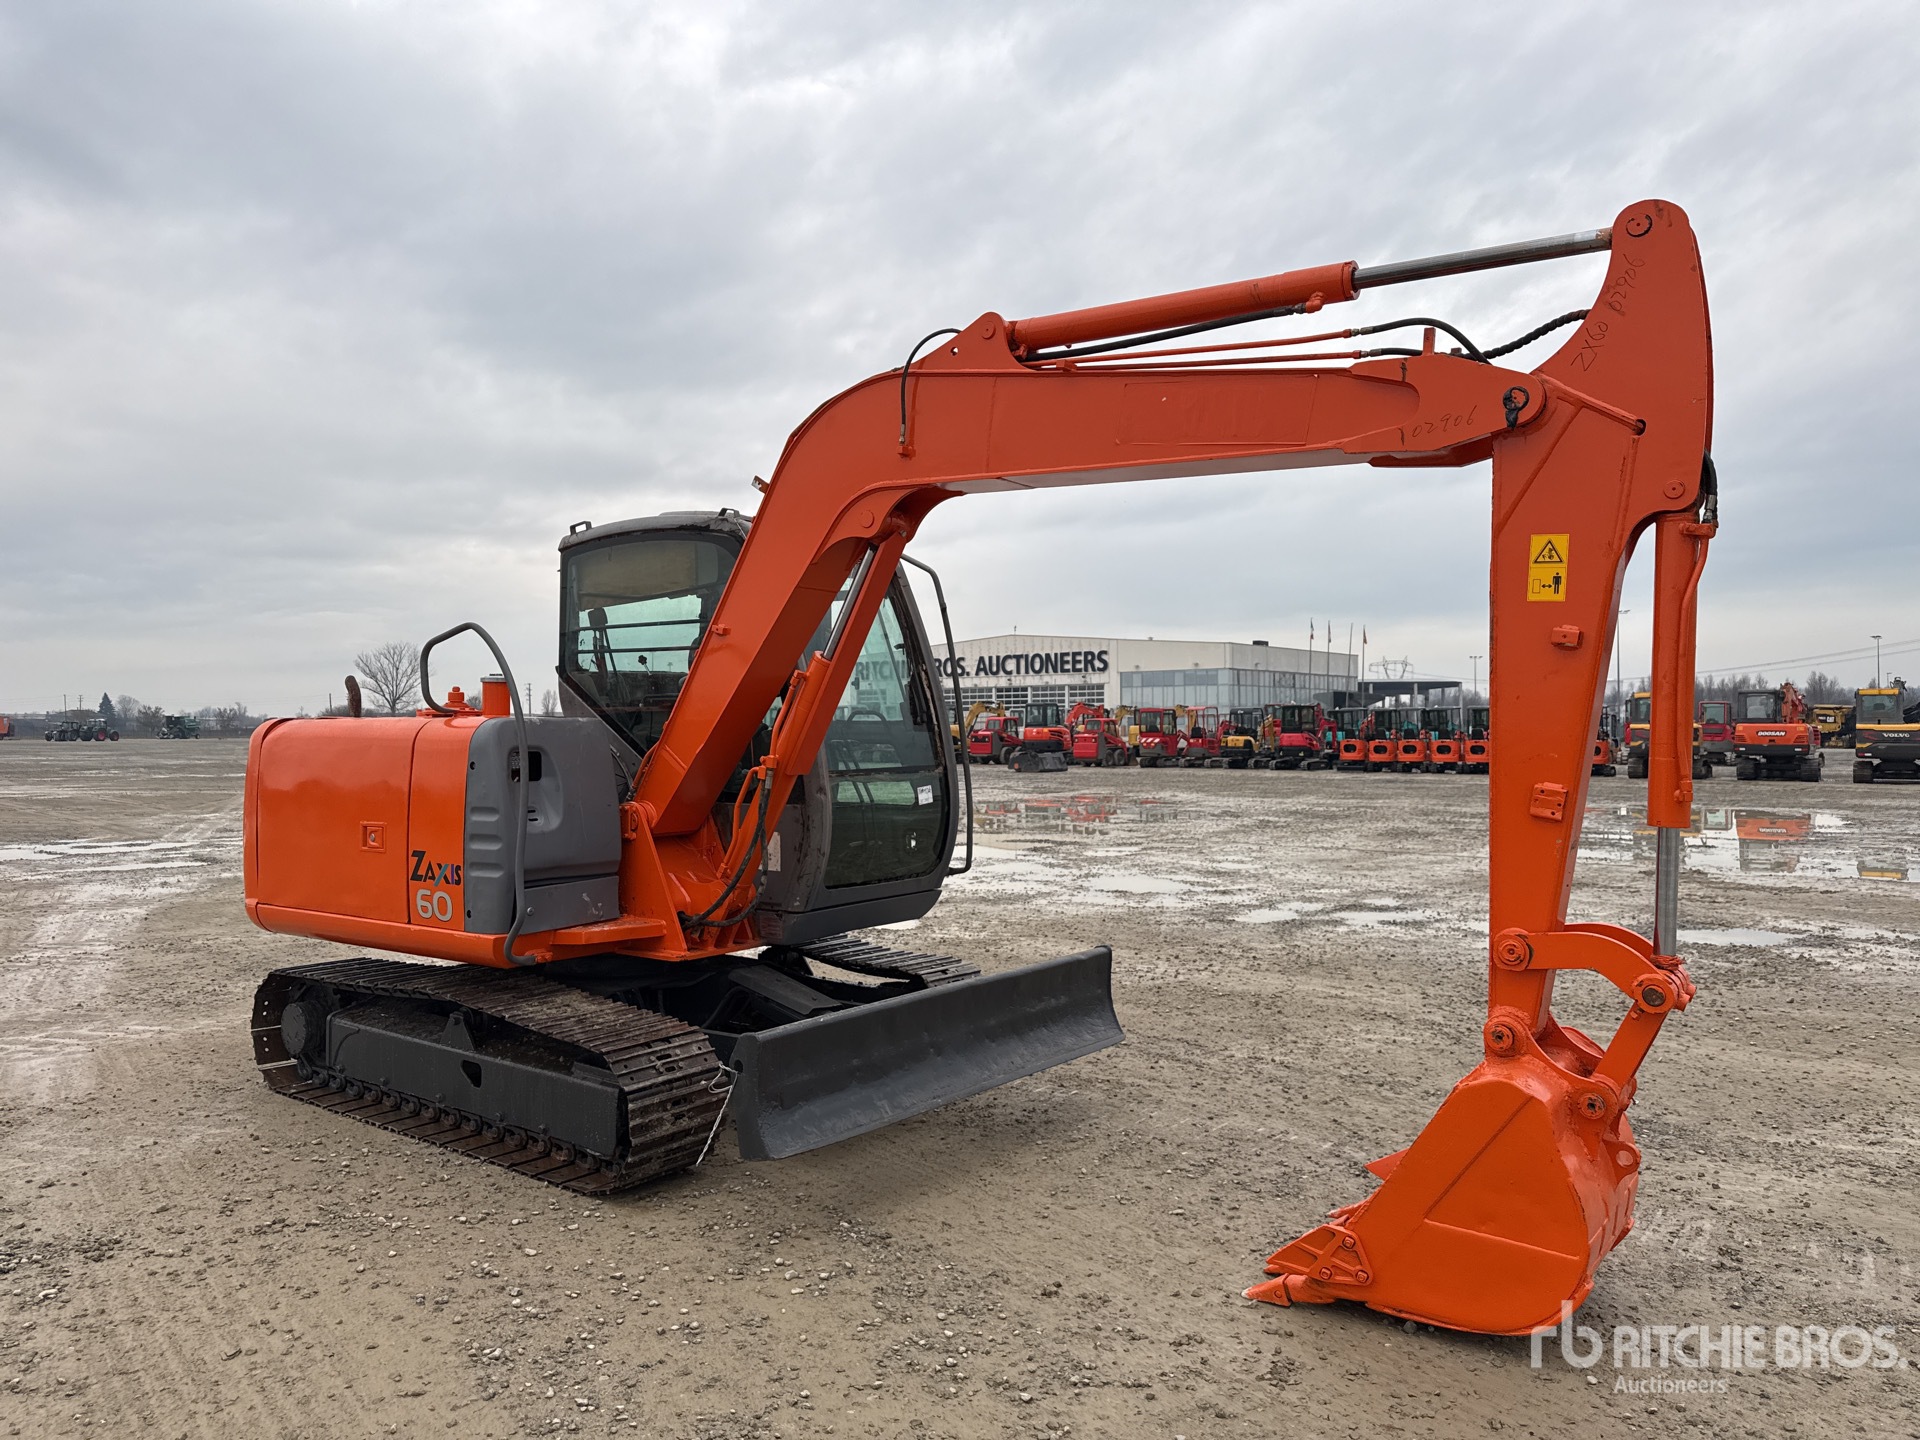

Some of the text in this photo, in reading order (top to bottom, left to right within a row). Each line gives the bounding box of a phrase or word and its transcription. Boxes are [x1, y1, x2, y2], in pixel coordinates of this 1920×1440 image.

[934, 656, 970, 677] ROS.
[975, 650, 1109, 676] AUCTIONEERS
[410, 850, 462, 887] ZAXIS
[416, 889, 453, 922] 60
